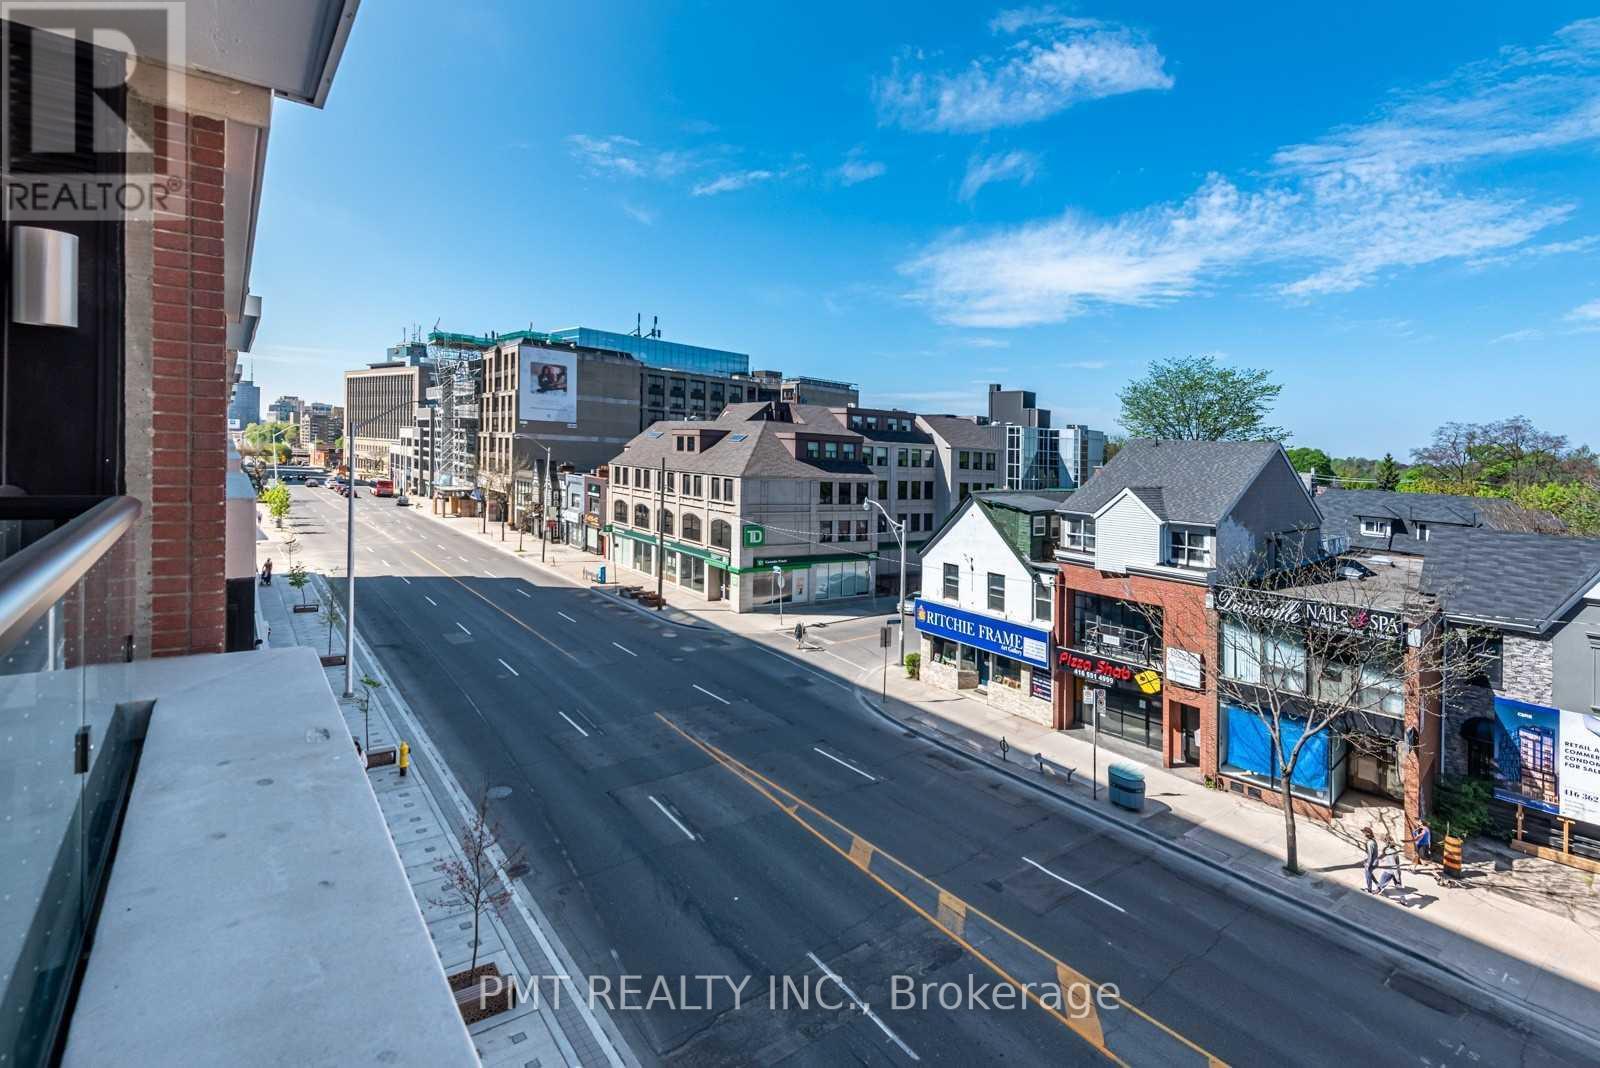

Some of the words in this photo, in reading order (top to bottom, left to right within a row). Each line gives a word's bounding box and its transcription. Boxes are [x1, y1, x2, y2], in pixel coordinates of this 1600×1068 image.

[747, 530, 763, 543] TD
[1307, 604, 1348, 625] NAILS
[1369, 614, 1398, 633] SPA
[926, 611, 975, 636] RITCHIE
[979, 624, 1024, 650] FRAME
[1059, 651, 1092, 671] Pizza
[1564, 741, 1592, 752] RETAIL
[1583, 766, 1600, 775] SALE
[1582, 793, 1600, 803] 362
